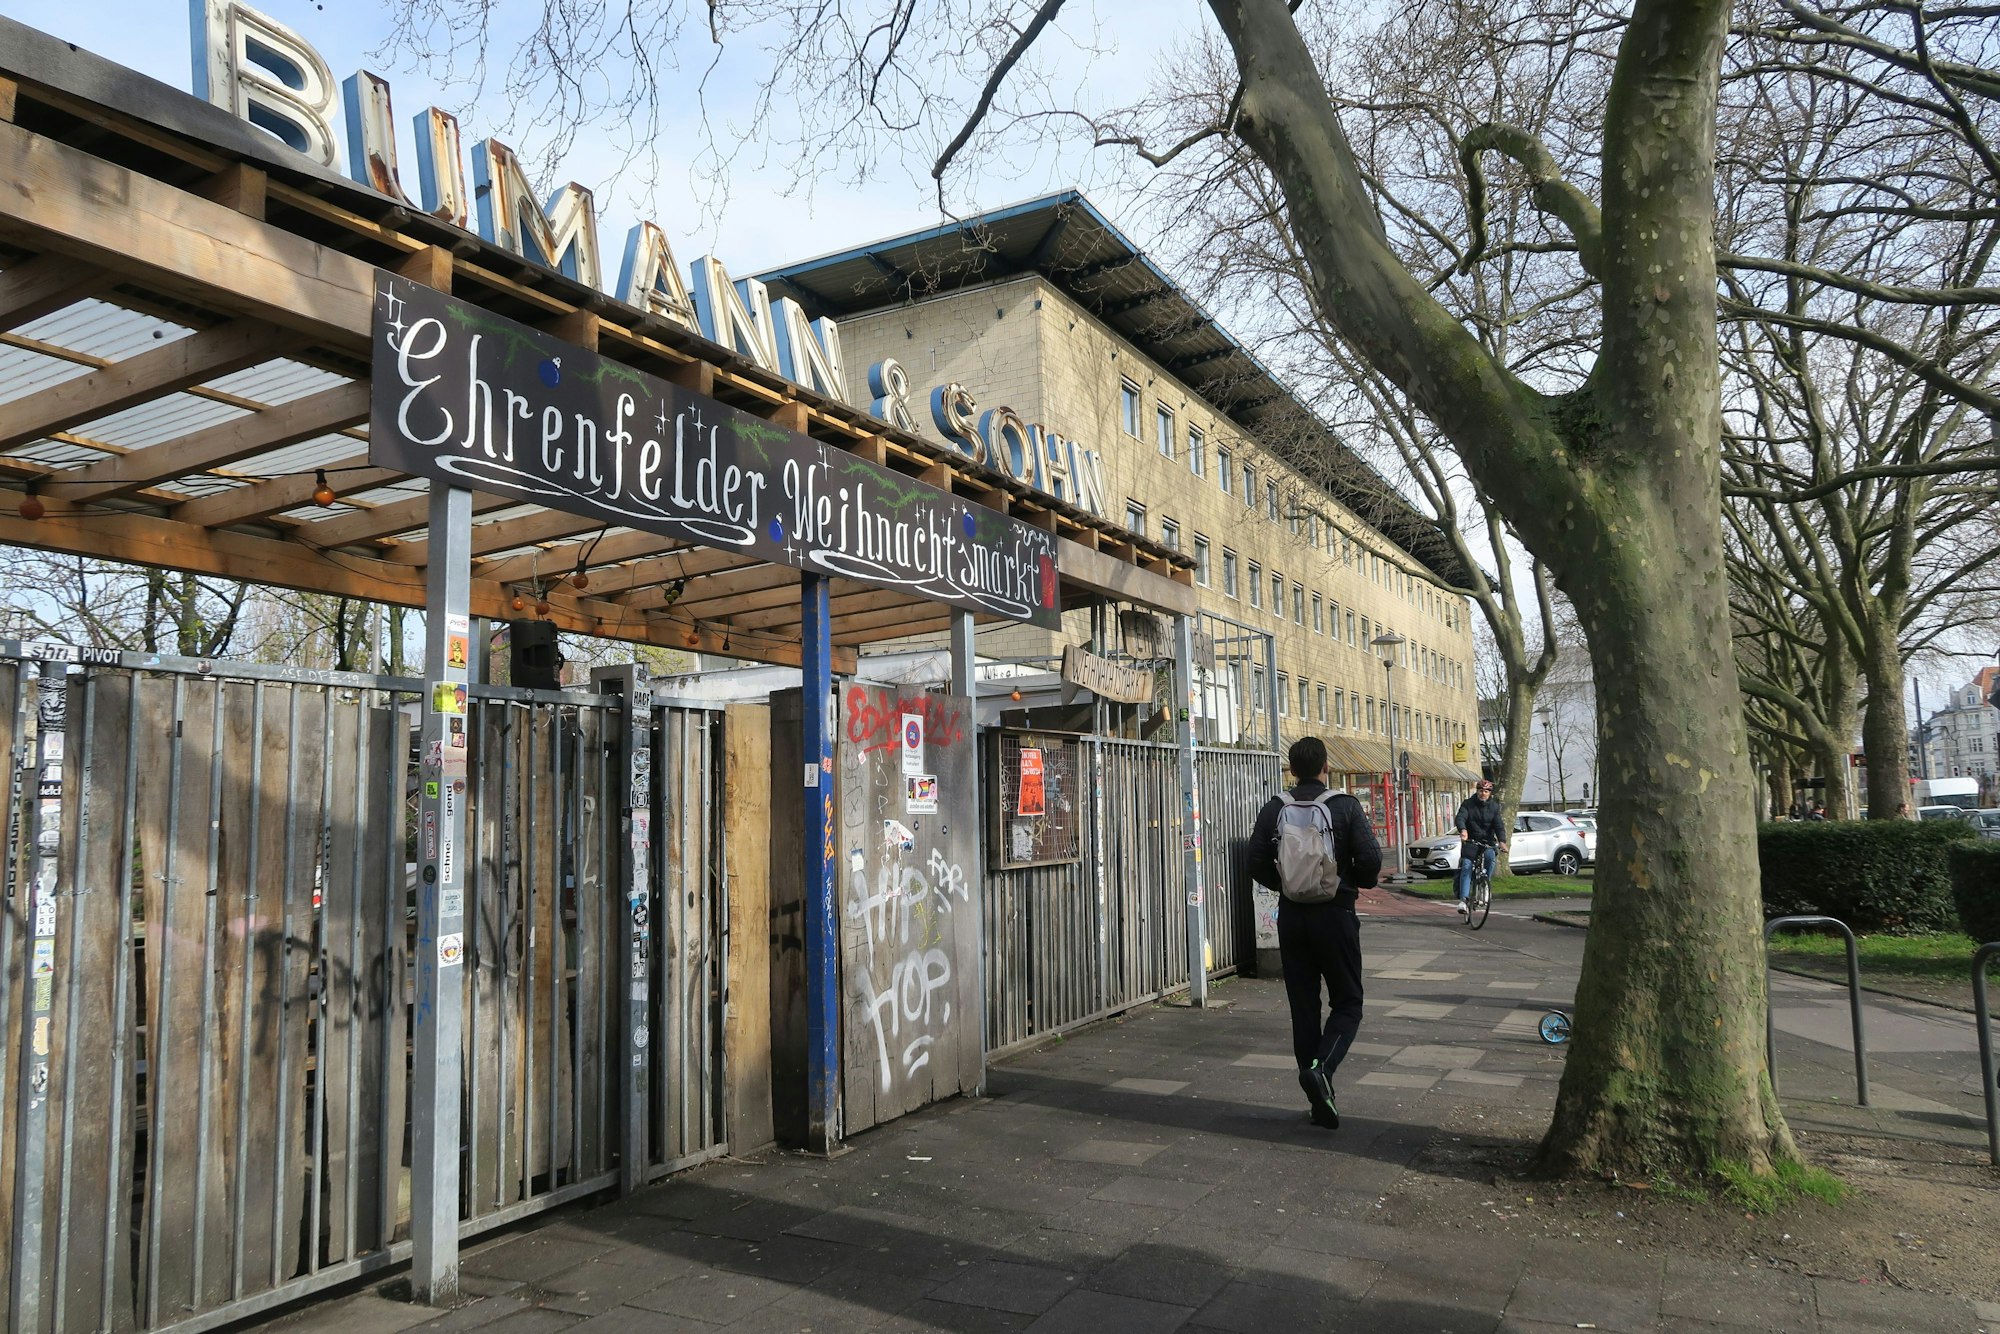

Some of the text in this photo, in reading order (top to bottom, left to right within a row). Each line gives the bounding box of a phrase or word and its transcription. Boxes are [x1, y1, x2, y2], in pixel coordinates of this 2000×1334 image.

[190, 0, 1107, 519] BUMANN & SOHN
[387, 317, 1042, 606] Ehrenfelder Weihnachtsmarkt
[83, 648, 121, 664] PIVOT
[1072, 648, 1147, 701] WEIHNACHTSMARKT
